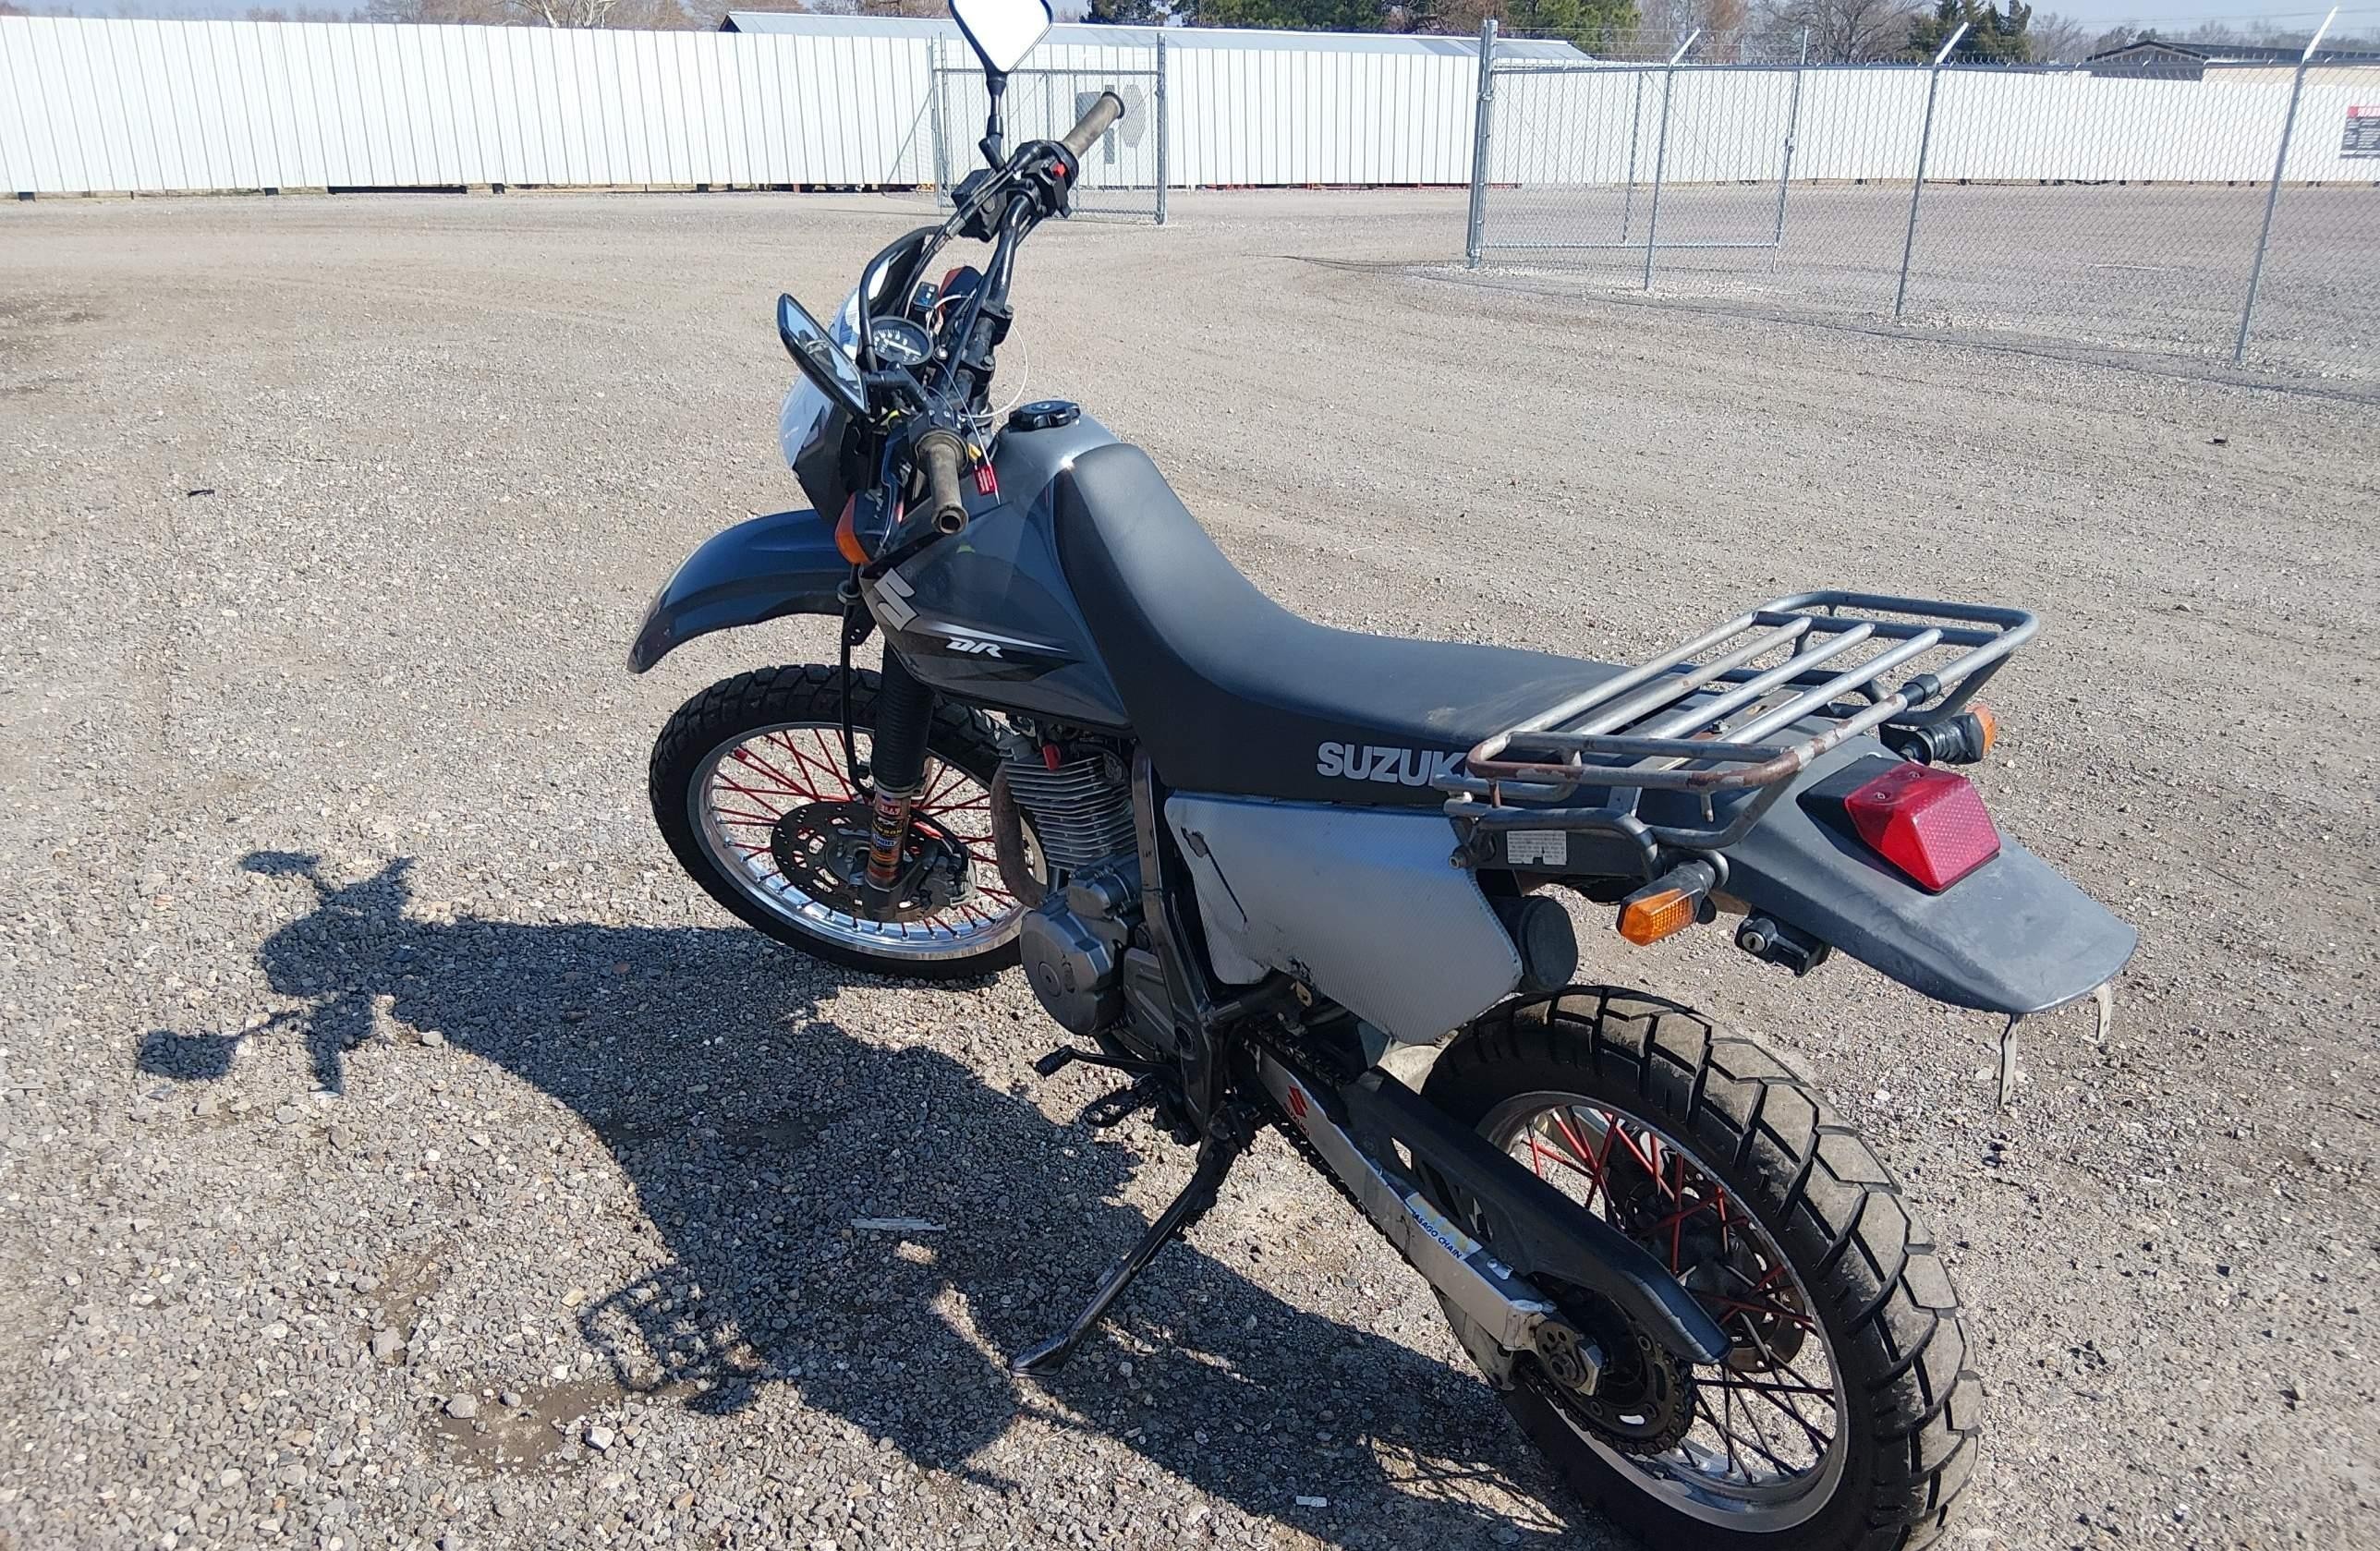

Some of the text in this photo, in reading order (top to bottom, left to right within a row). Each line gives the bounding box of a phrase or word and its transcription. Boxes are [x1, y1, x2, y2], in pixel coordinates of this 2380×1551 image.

[946, 636, 1003, 658] DR
[1317, 742, 1473, 787] SUZUK
[1413, 1210, 1463, 1259] ASAGO CHAIN
